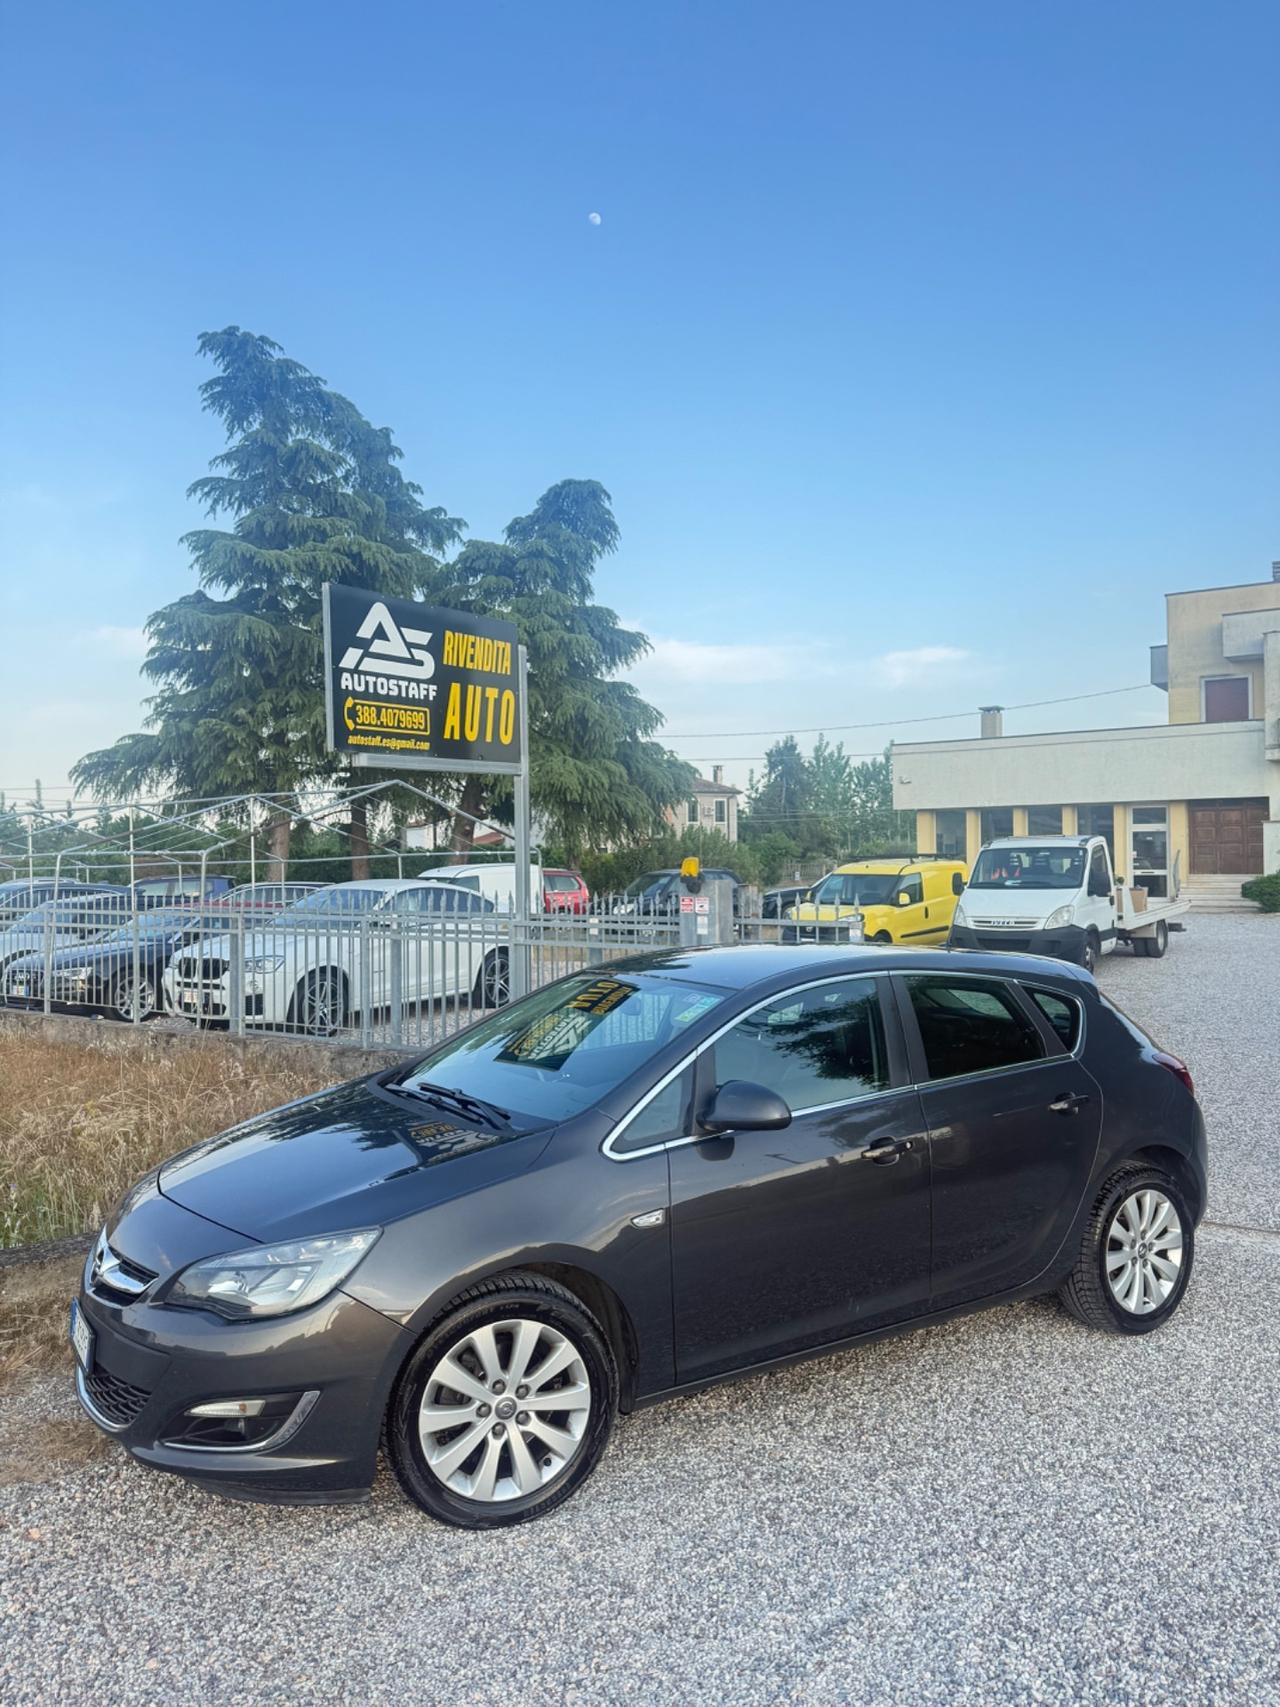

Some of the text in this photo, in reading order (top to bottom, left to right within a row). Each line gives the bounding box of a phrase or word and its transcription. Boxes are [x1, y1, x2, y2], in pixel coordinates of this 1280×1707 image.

[443, 630, 511, 675] RIVENDITA
[341, 673, 437, 700] AUTOSTAFF
[356, 705, 425, 729] 388.4079699
[444, 683, 515, 745] AUTO
